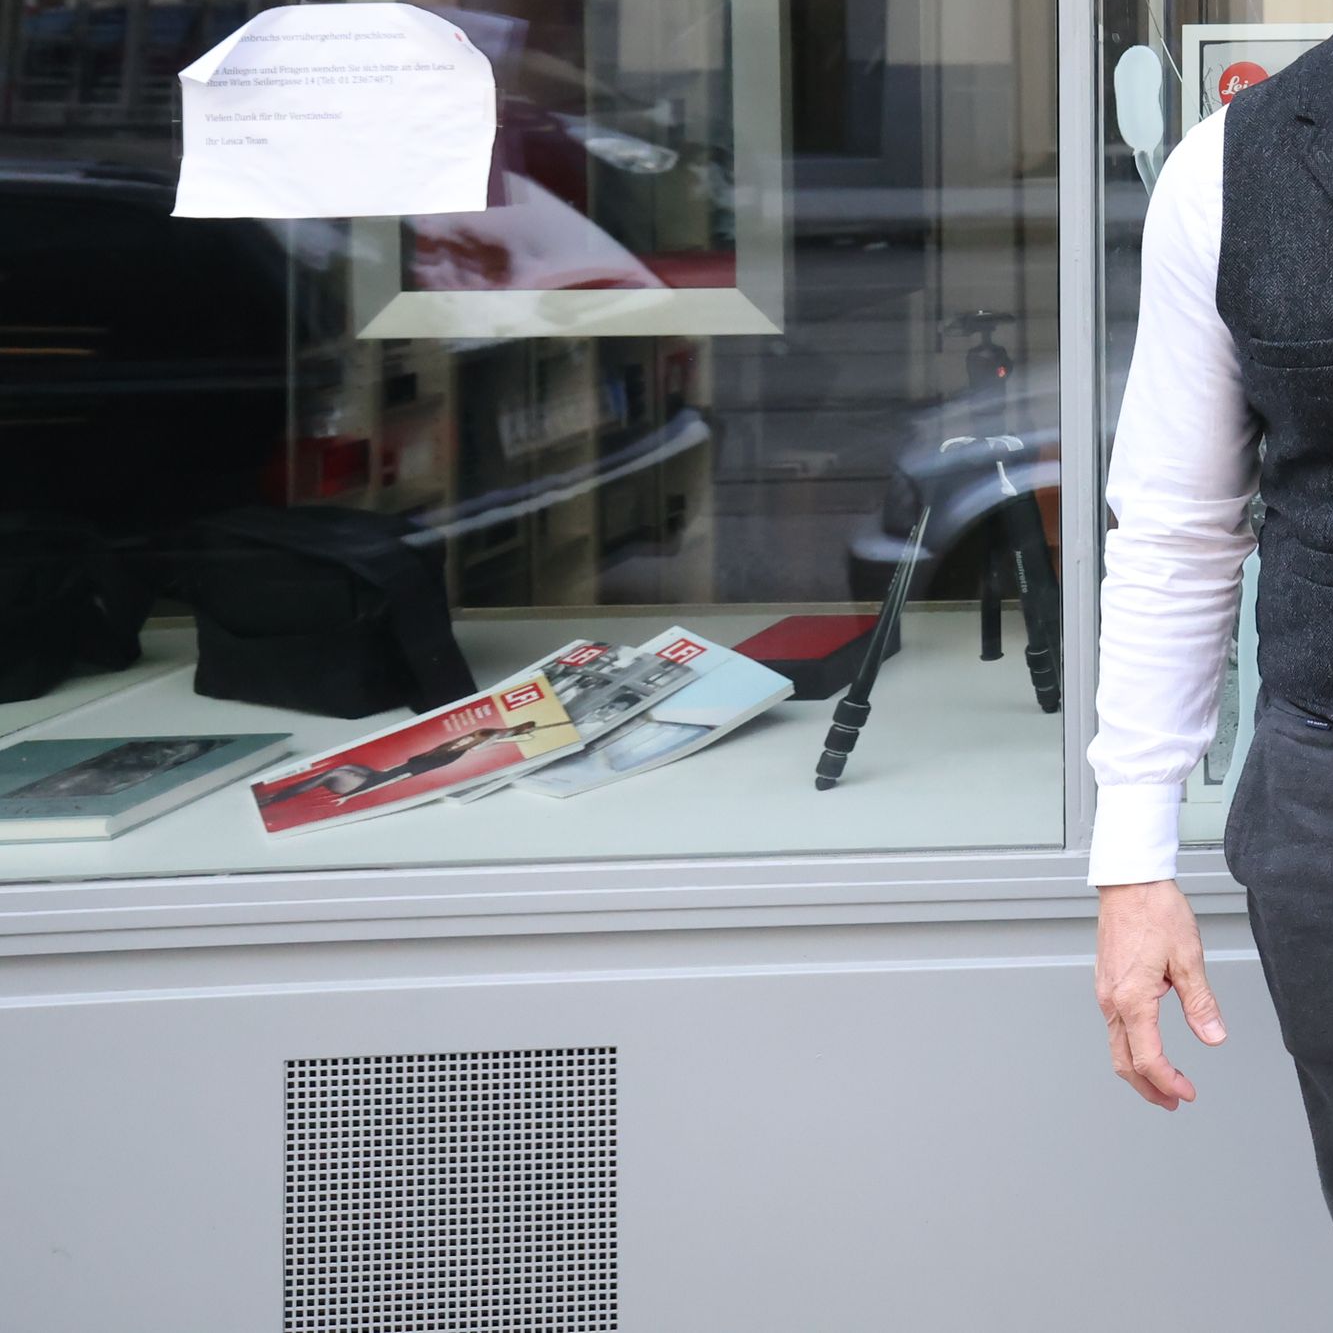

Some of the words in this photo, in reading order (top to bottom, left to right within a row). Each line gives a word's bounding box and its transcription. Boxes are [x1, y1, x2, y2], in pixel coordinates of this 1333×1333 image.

[258, 65, 278, 74] und
[279, 65, 310, 76] Fragen
[229, 77, 252, 87] Wien
[1221, 75, 1253, 95] Lei
[204, 113, 233, 122] Vielen
[234, 112, 257, 122] Dank
[258, 112, 273, 121] für
[245, 136, 269, 145] Team
